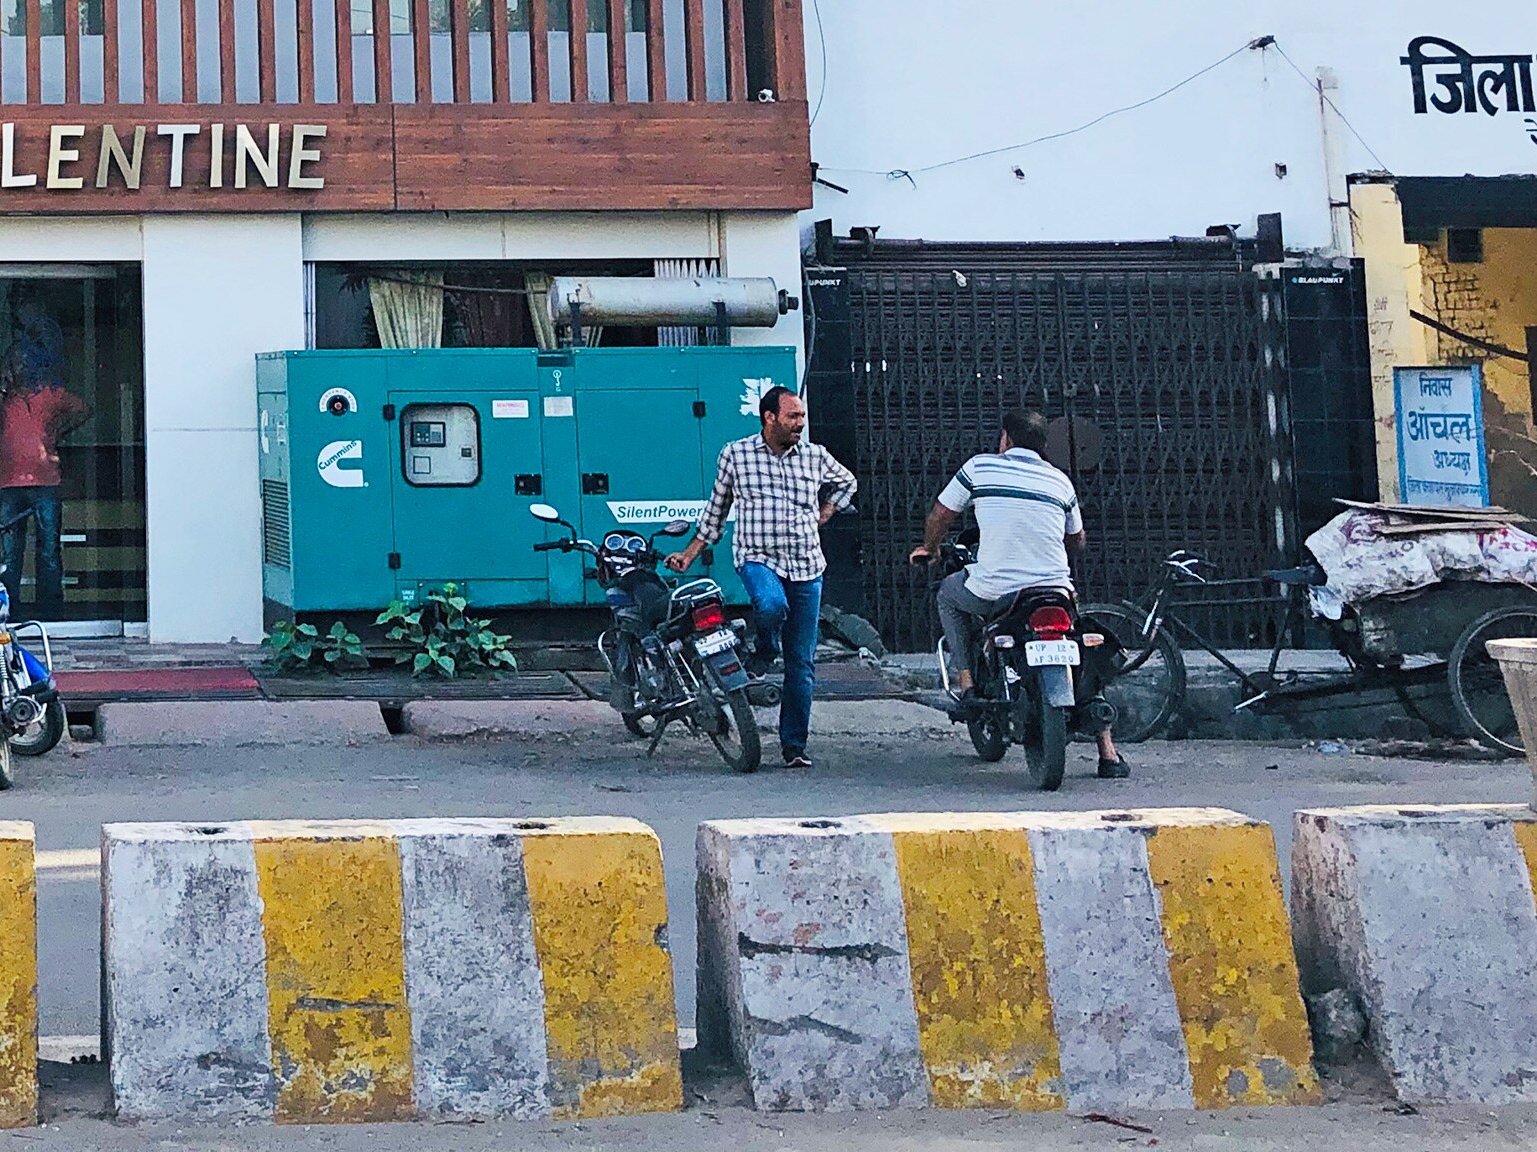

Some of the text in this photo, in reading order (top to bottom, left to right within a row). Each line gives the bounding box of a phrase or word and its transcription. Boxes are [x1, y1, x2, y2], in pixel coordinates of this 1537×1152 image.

[1399, 35, 1536, 117] जिला
[318, 441, 357, 470] Cummins
[617, 505, 702, 519] SilentPower
